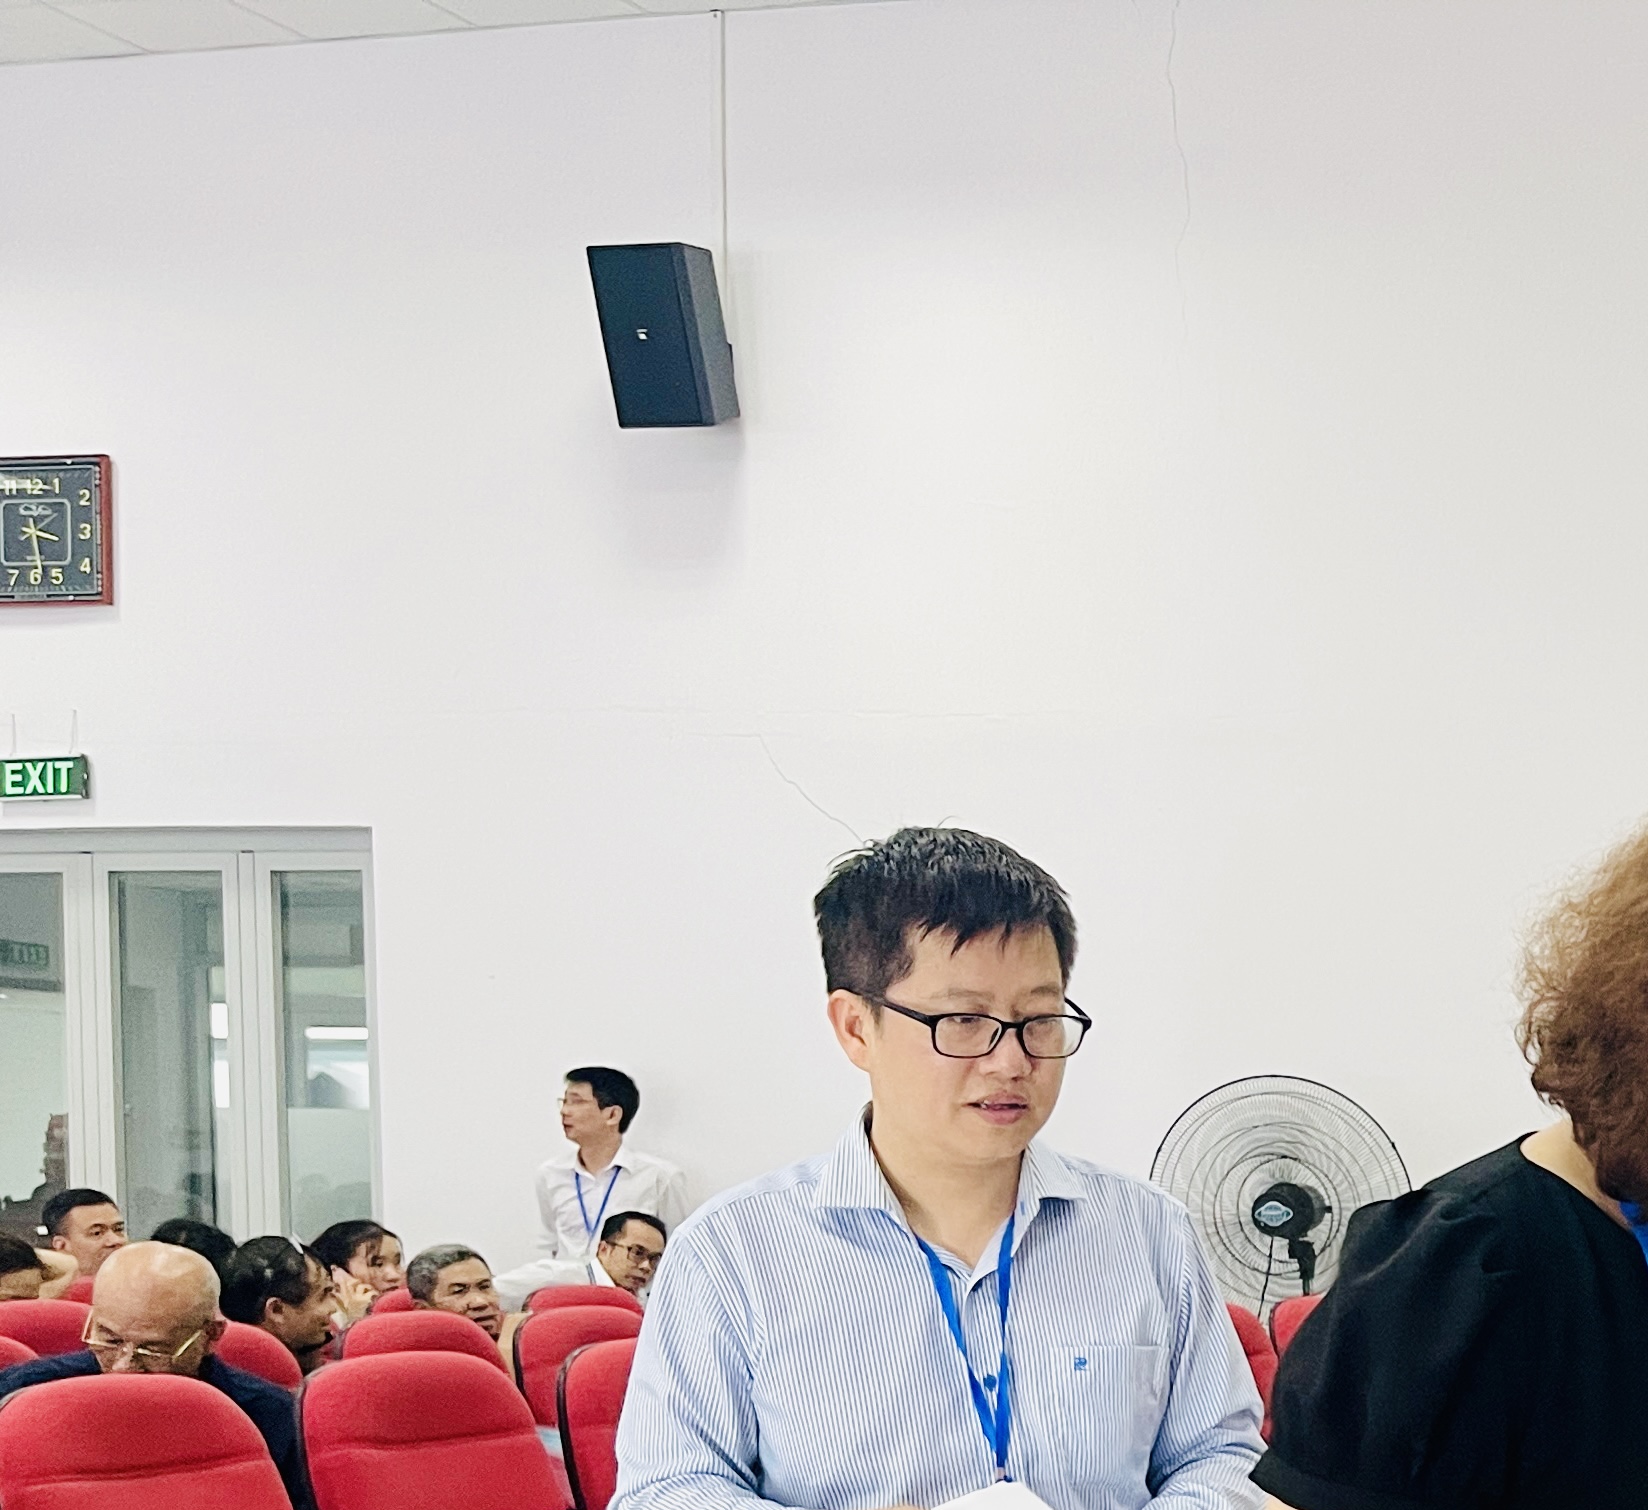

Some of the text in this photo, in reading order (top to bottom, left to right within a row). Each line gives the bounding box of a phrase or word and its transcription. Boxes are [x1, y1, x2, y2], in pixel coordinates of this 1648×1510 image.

[26, 479, 44, 495] 12
[52, 478, 60, 494] 1
[79, 489, 91, 506] 2
[78, 523, 92, 540] 3
[80, 557, 91, 574] 4
[7, 568, 64, 586] 7 6 5
[4, 761, 74, 795] EXIT
